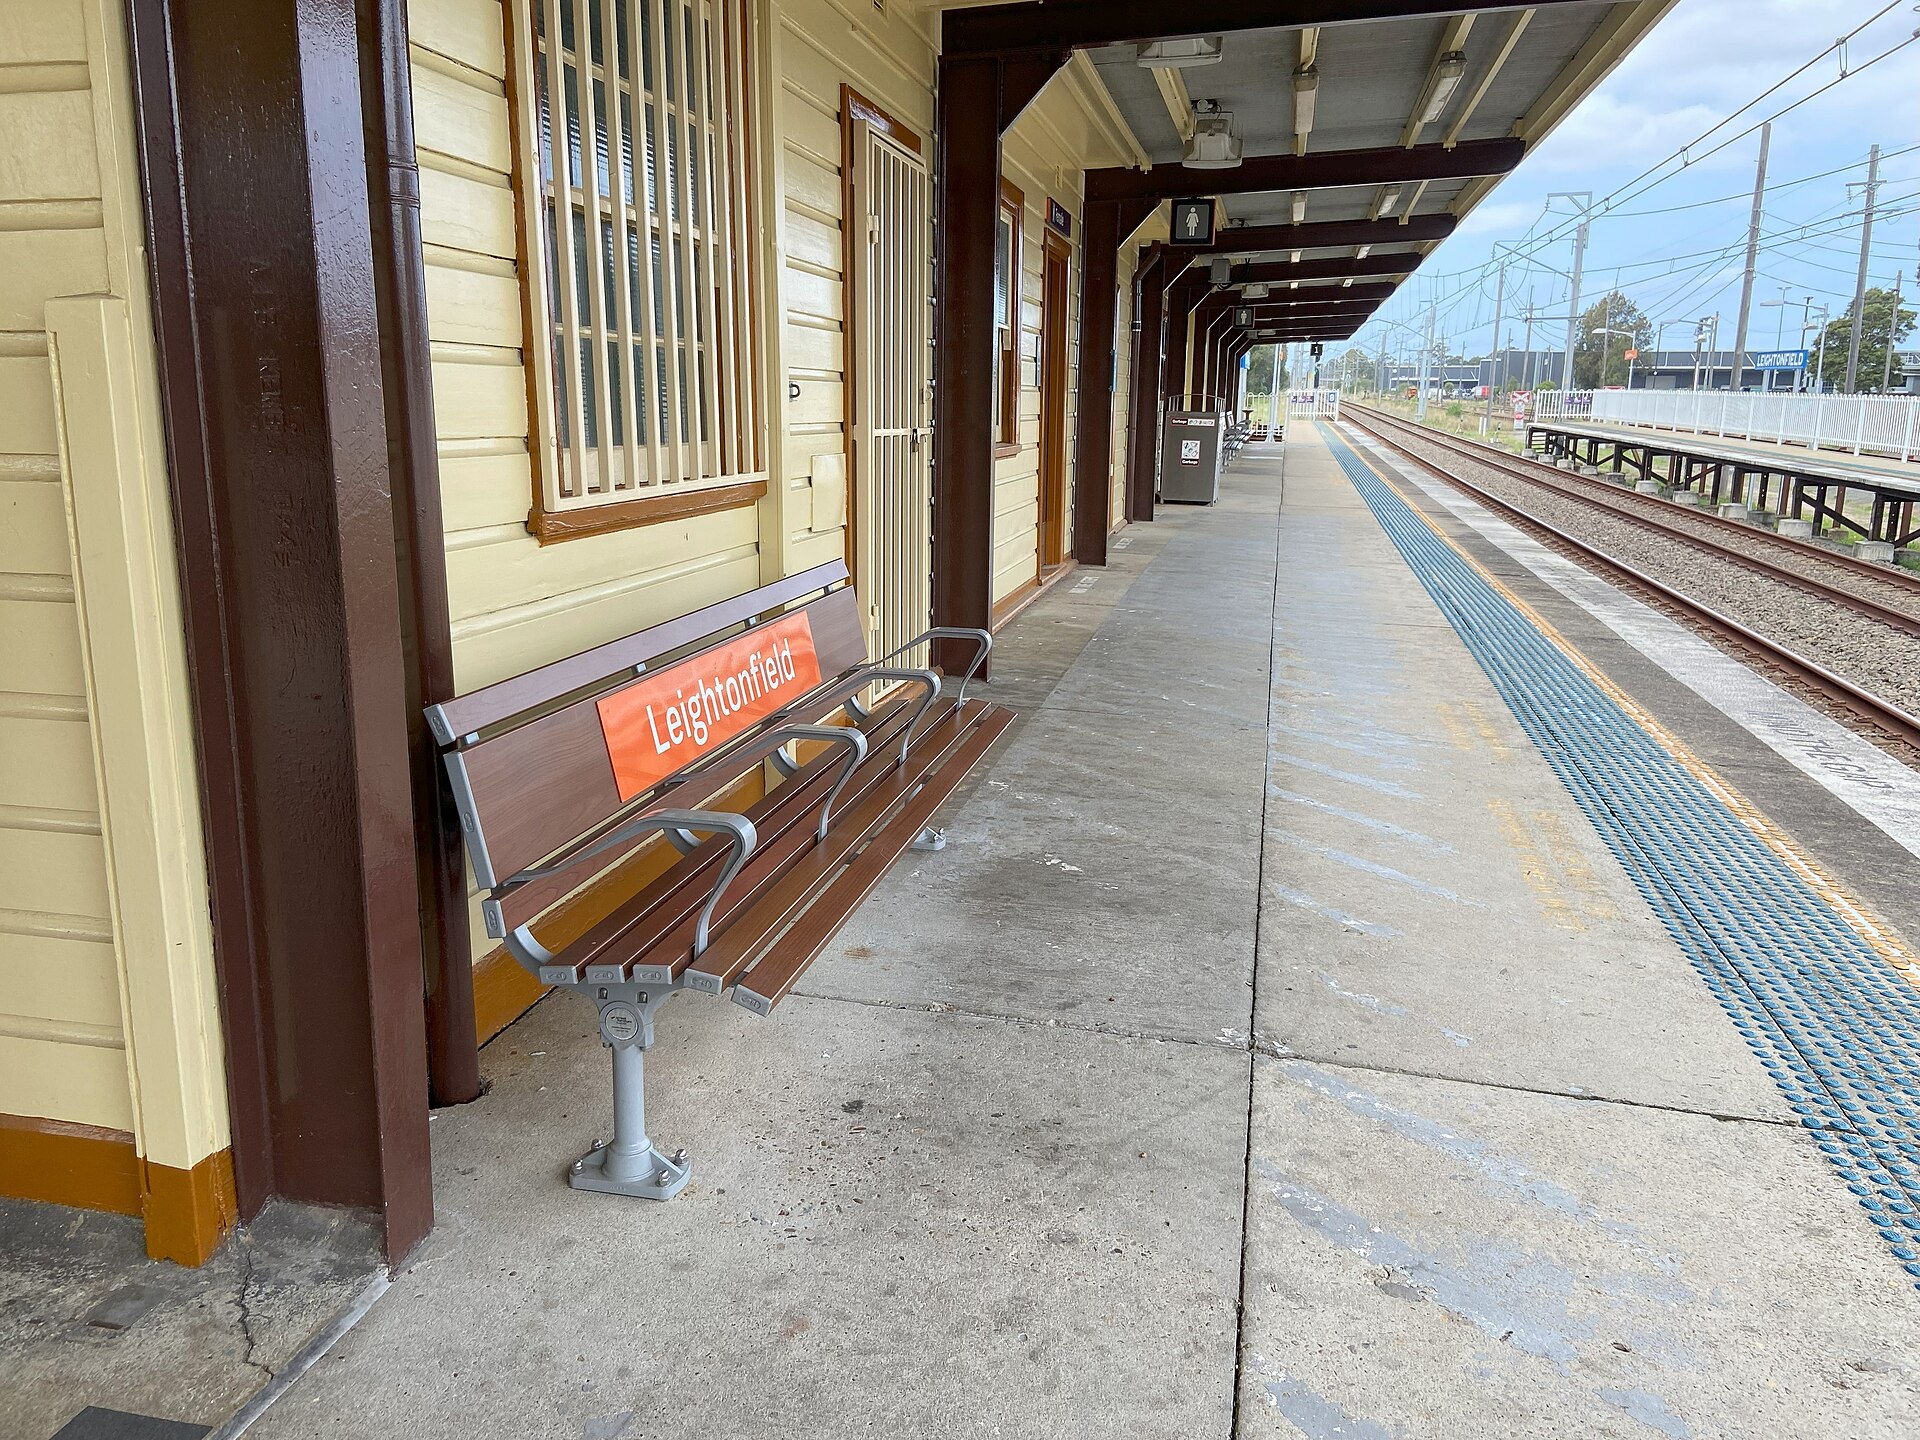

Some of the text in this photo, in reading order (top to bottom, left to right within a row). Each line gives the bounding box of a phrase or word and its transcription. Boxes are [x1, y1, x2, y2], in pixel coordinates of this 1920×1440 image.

[1314, 346, 1319, 354] 1
[1756, 352, 1804, 367] LEIGHTONFIELD
[645, 637, 796, 755] Leightonfield
[1786, 737, 1852, 763] THE
[1820, 761, 1896, 790] GAP
